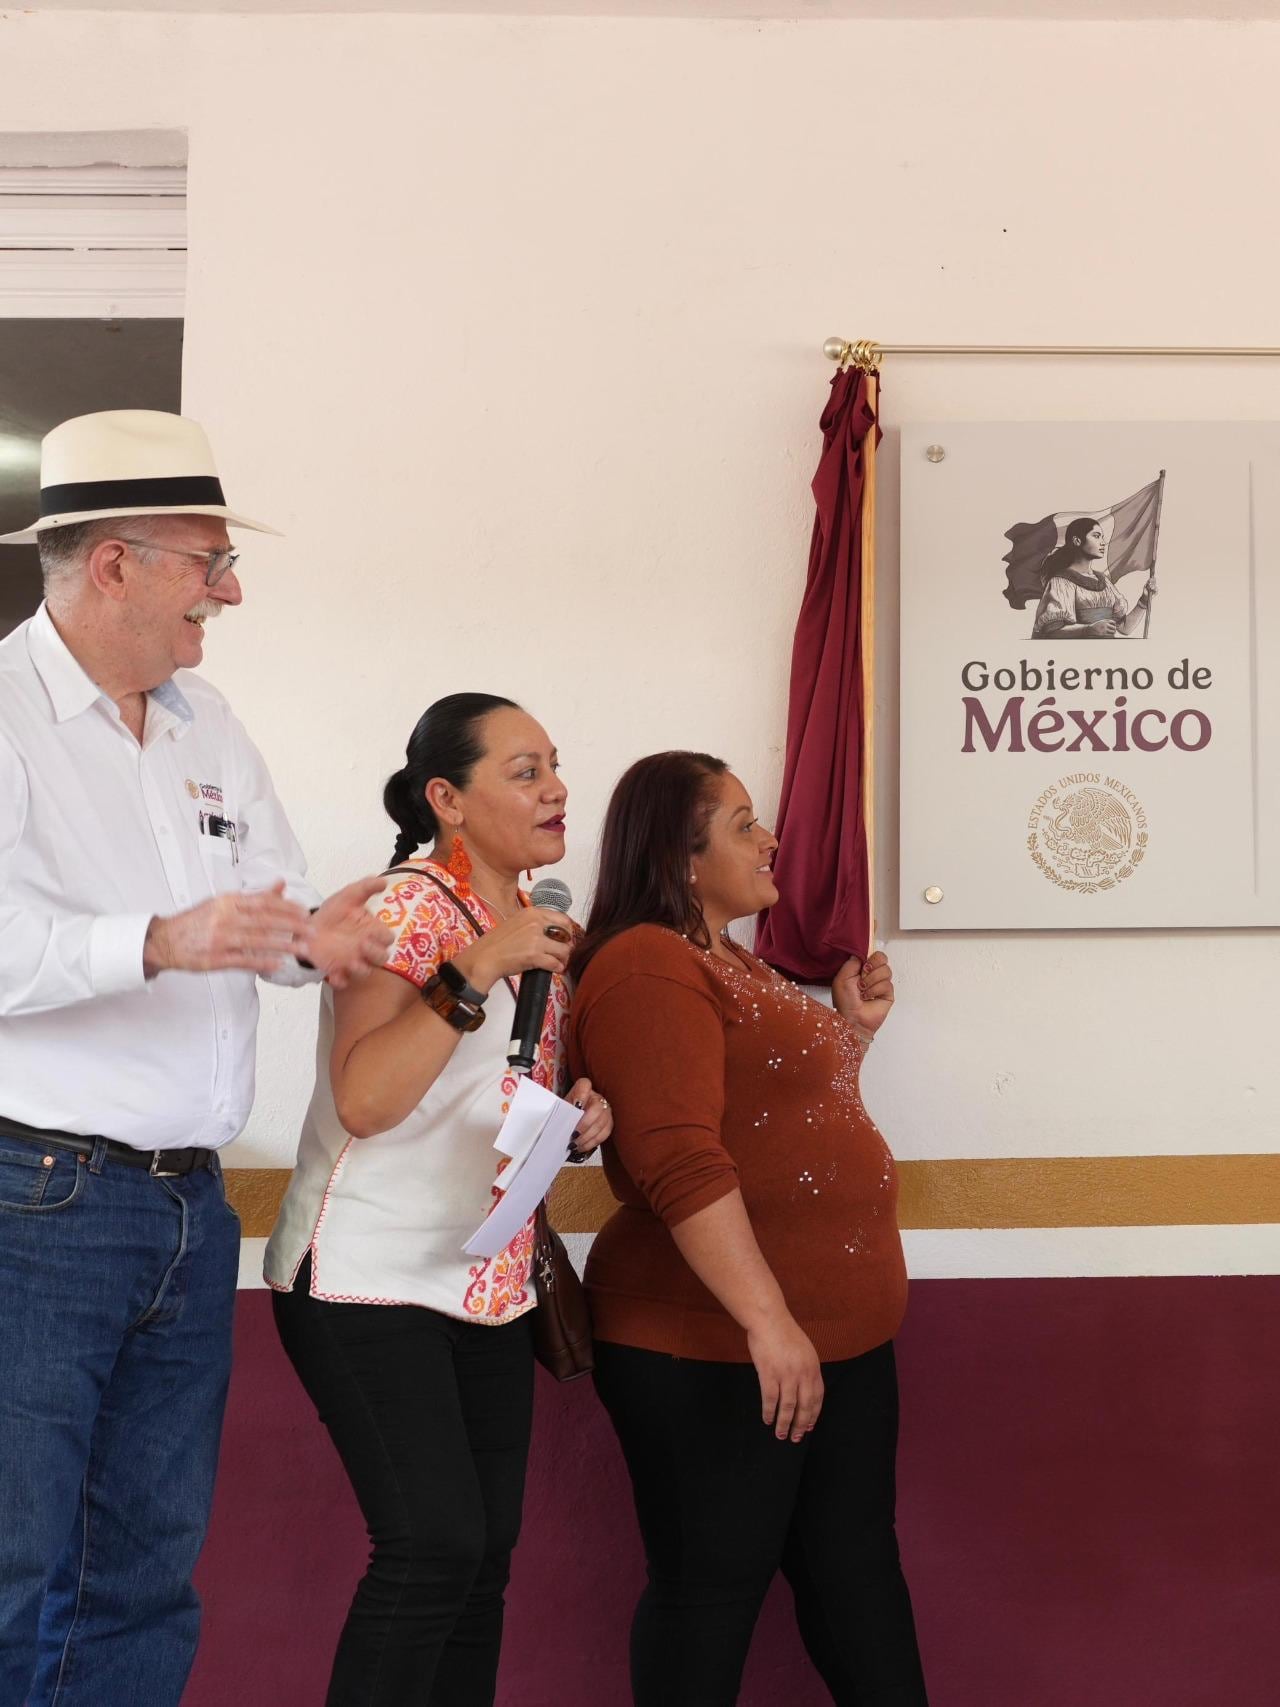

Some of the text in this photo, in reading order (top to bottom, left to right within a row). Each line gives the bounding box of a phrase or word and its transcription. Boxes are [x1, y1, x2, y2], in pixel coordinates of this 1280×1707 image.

[961, 658, 1213, 692] Gobierno de
[960, 695, 1213, 753] México
[1027, 772, 1148, 830] ESTADOS UNIDOS MEXICANOS
